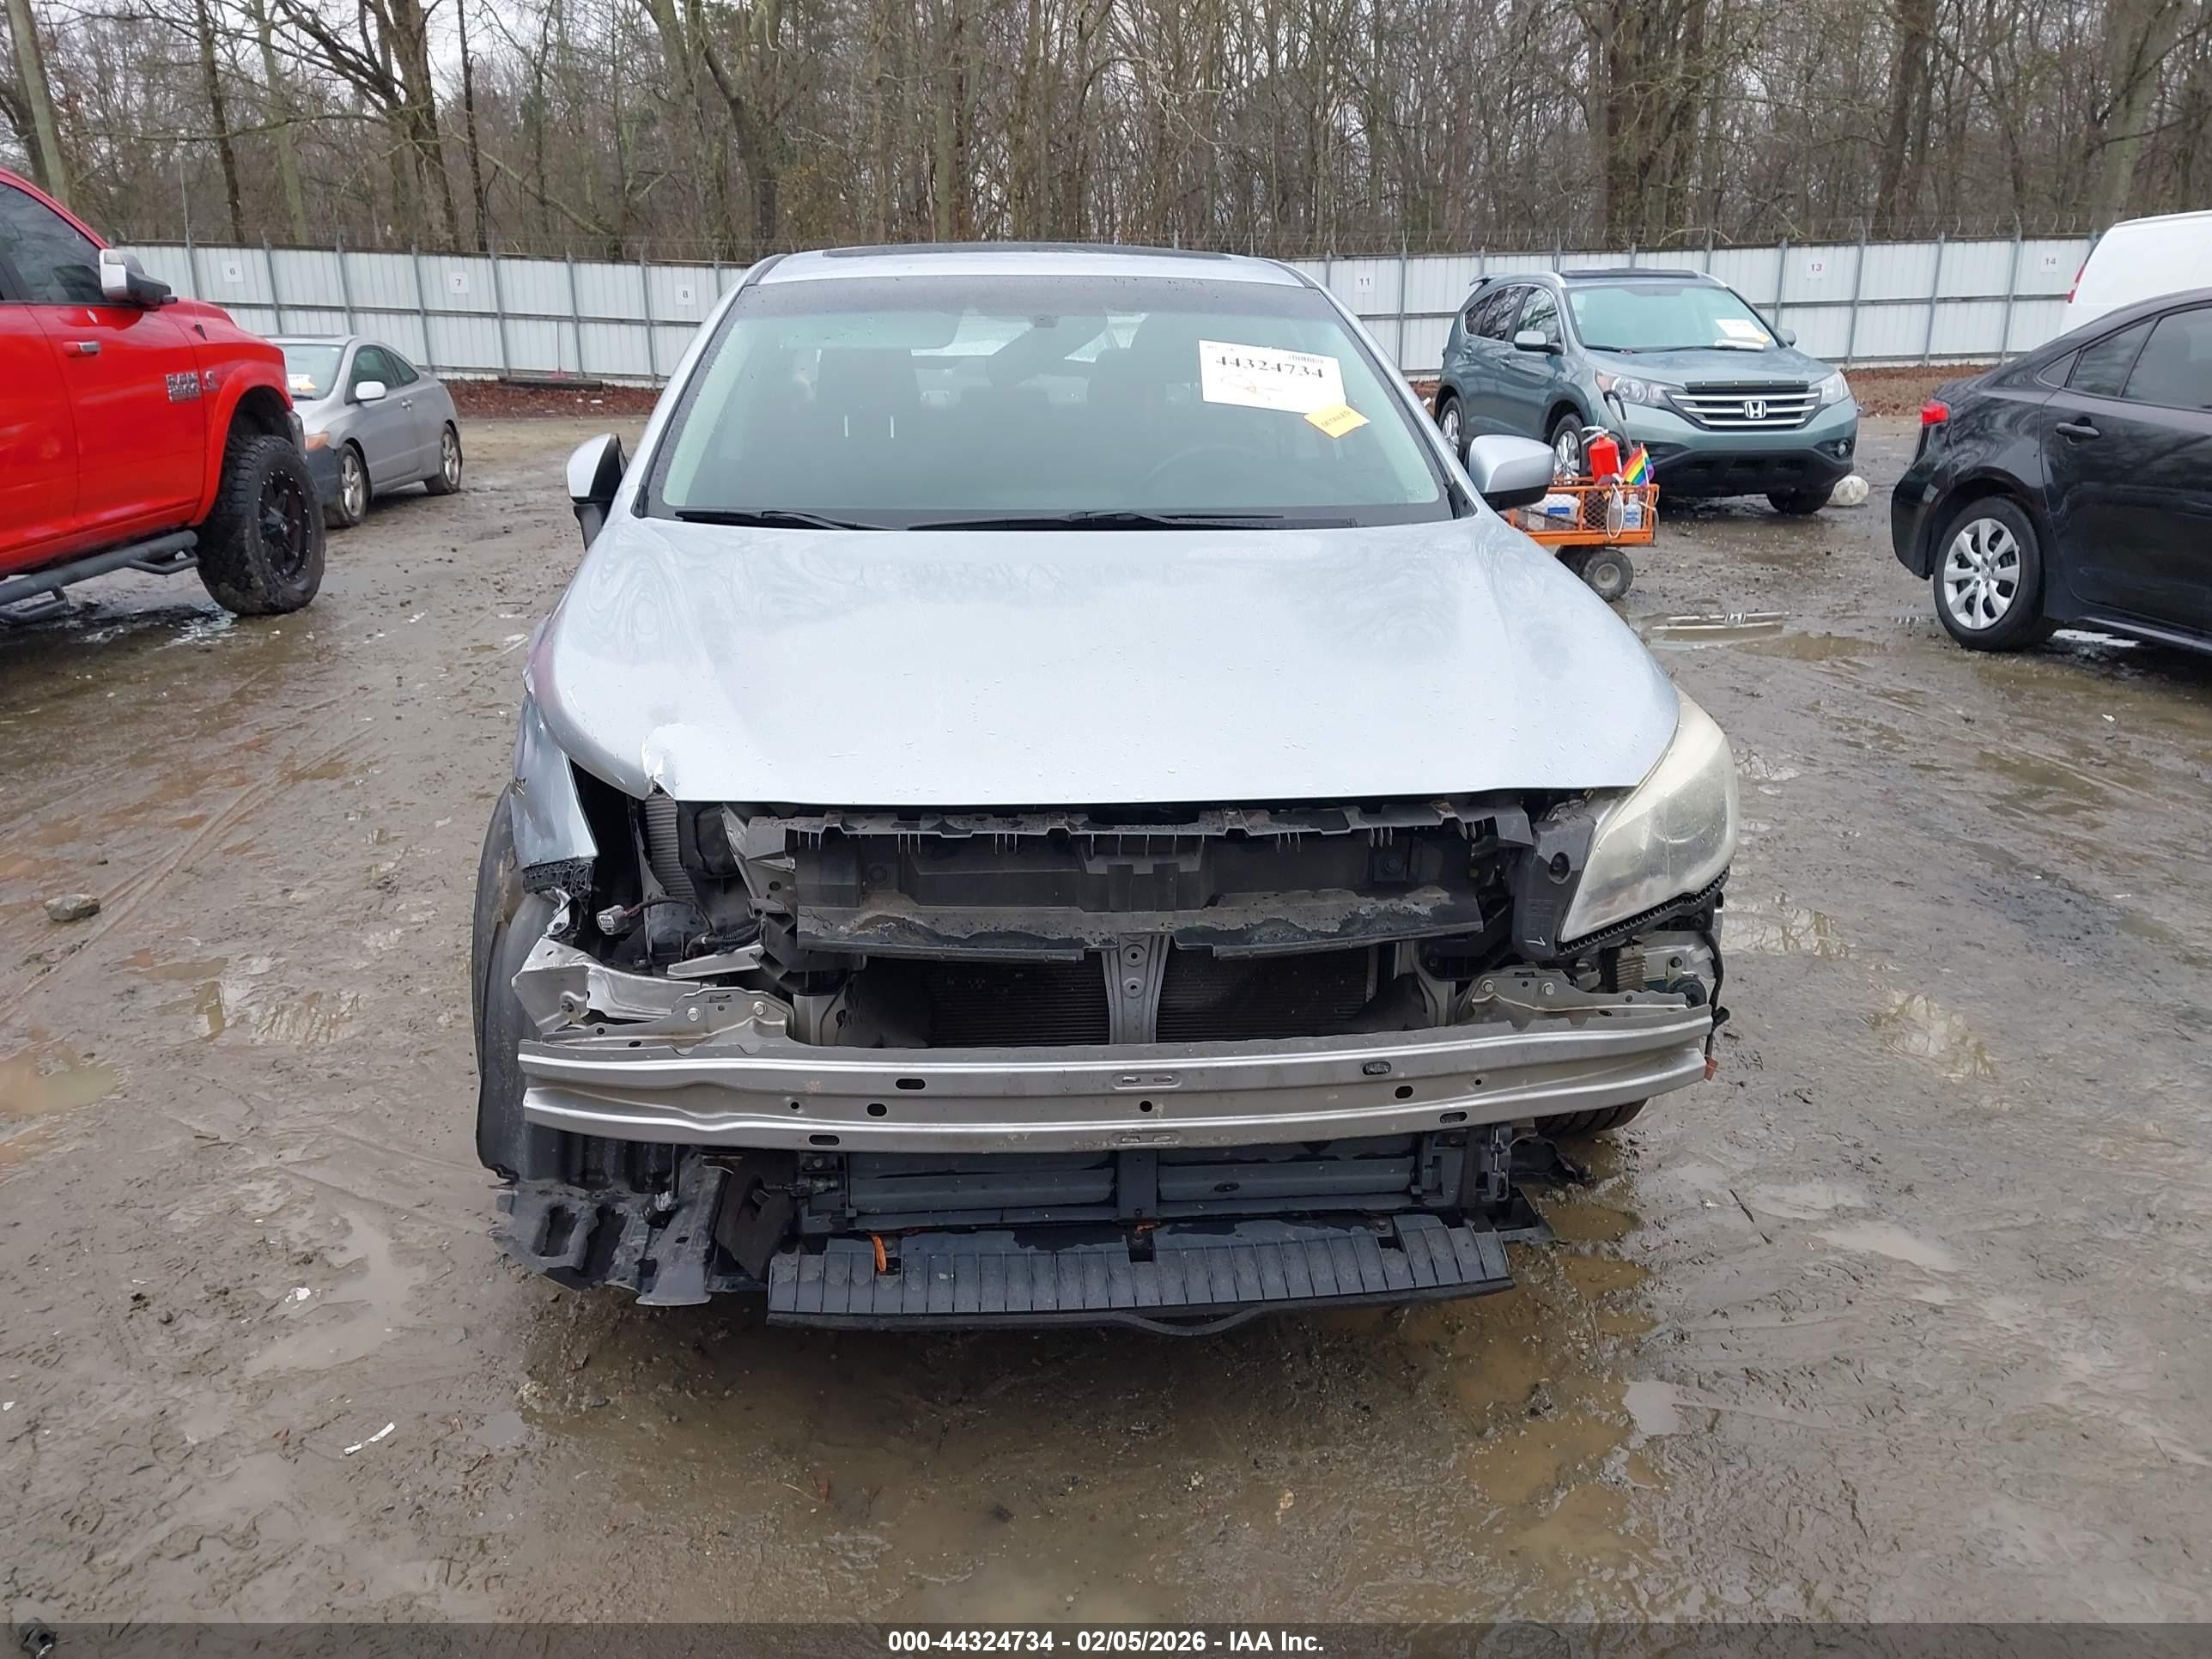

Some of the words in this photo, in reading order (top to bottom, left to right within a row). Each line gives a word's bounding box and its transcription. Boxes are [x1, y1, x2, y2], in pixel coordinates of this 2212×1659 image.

[1811, 263, 1822, 271] 13
[1359, 277, 1370, 286] 11
[1216, 356, 1323, 378] 44324734
